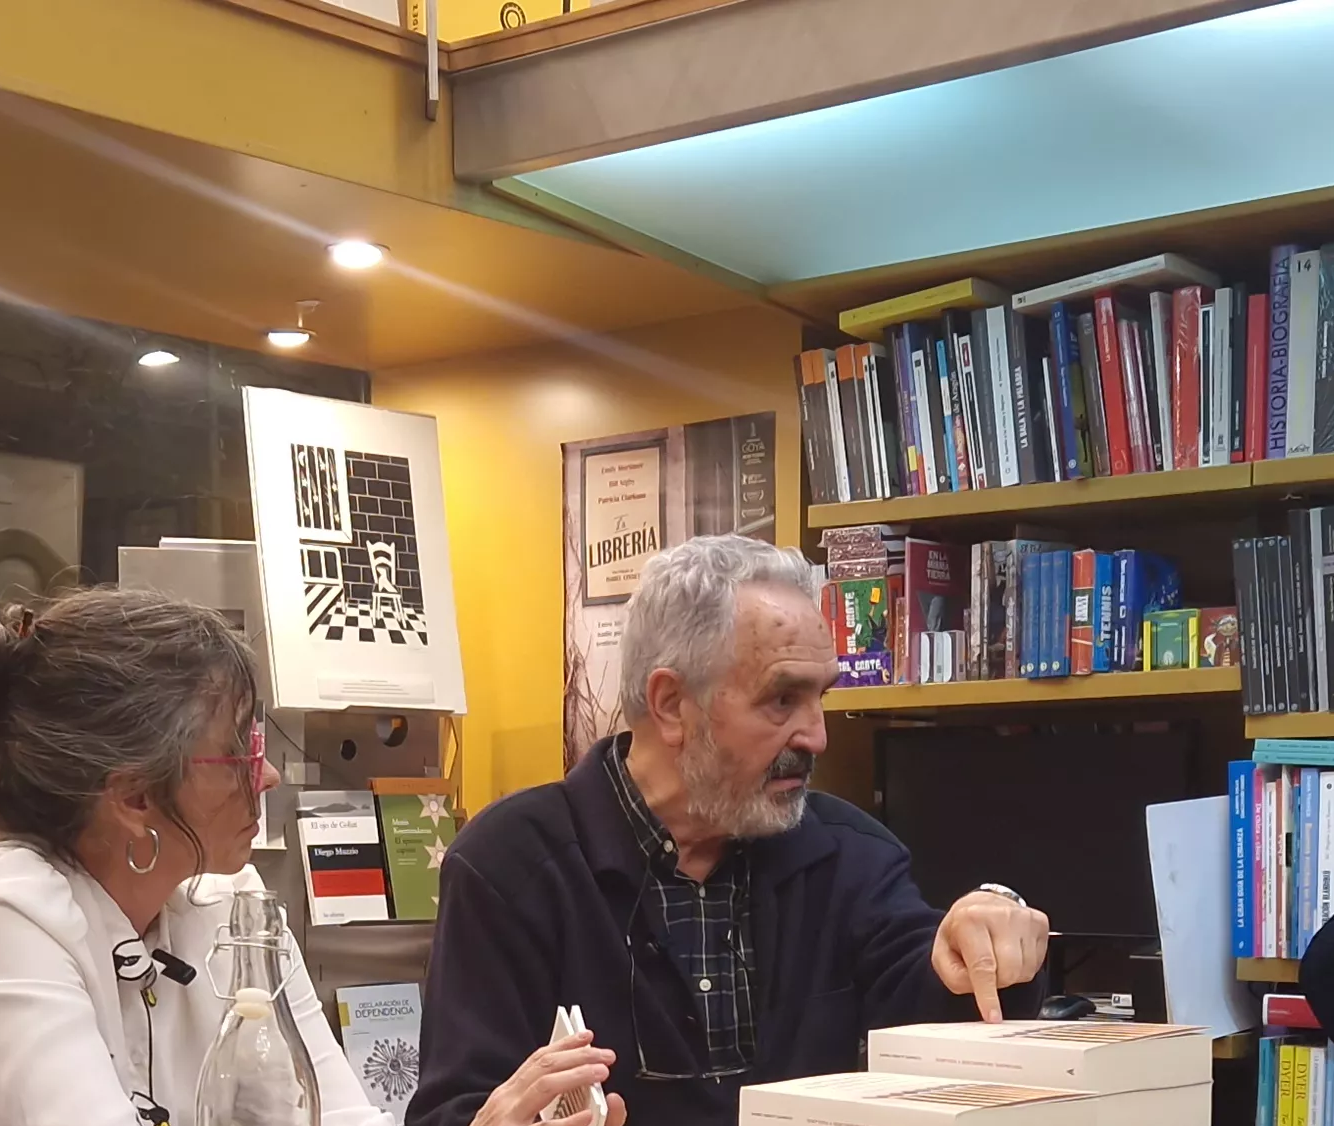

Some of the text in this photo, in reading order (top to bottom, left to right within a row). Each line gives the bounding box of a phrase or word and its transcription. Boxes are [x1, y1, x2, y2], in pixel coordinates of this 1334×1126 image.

[1296, 258, 1312, 274] 14
[1016, 399, 1026, 410] LA
[1018, 416, 1028, 437] BALA
[741, 441, 766, 453] GOYA
[1019, 437, 1028, 449] LA
[588, 521, 658, 569] LIBRERÍA
[1100, 585, 1112, 642] TENNIS
[310, 820, 319, 830] El
[330, 820, 339, 829] de
[314, 847, 334, 858] Diego
[1236, 859, 1244, 868] LA
[1236, 868, 1244, 879] DE
[1236, 898, 1245, 918] GRAN
[1237, 918, 1244, 928] LA
[358, 999, 410, 1009] DECLARACIÓN DE
[354, 1005, 415, 1019] DEPENDENCIA
[1280, 1060, 1292, 1099] DYER
[1295, 1062, 1308, 1100] DYER
